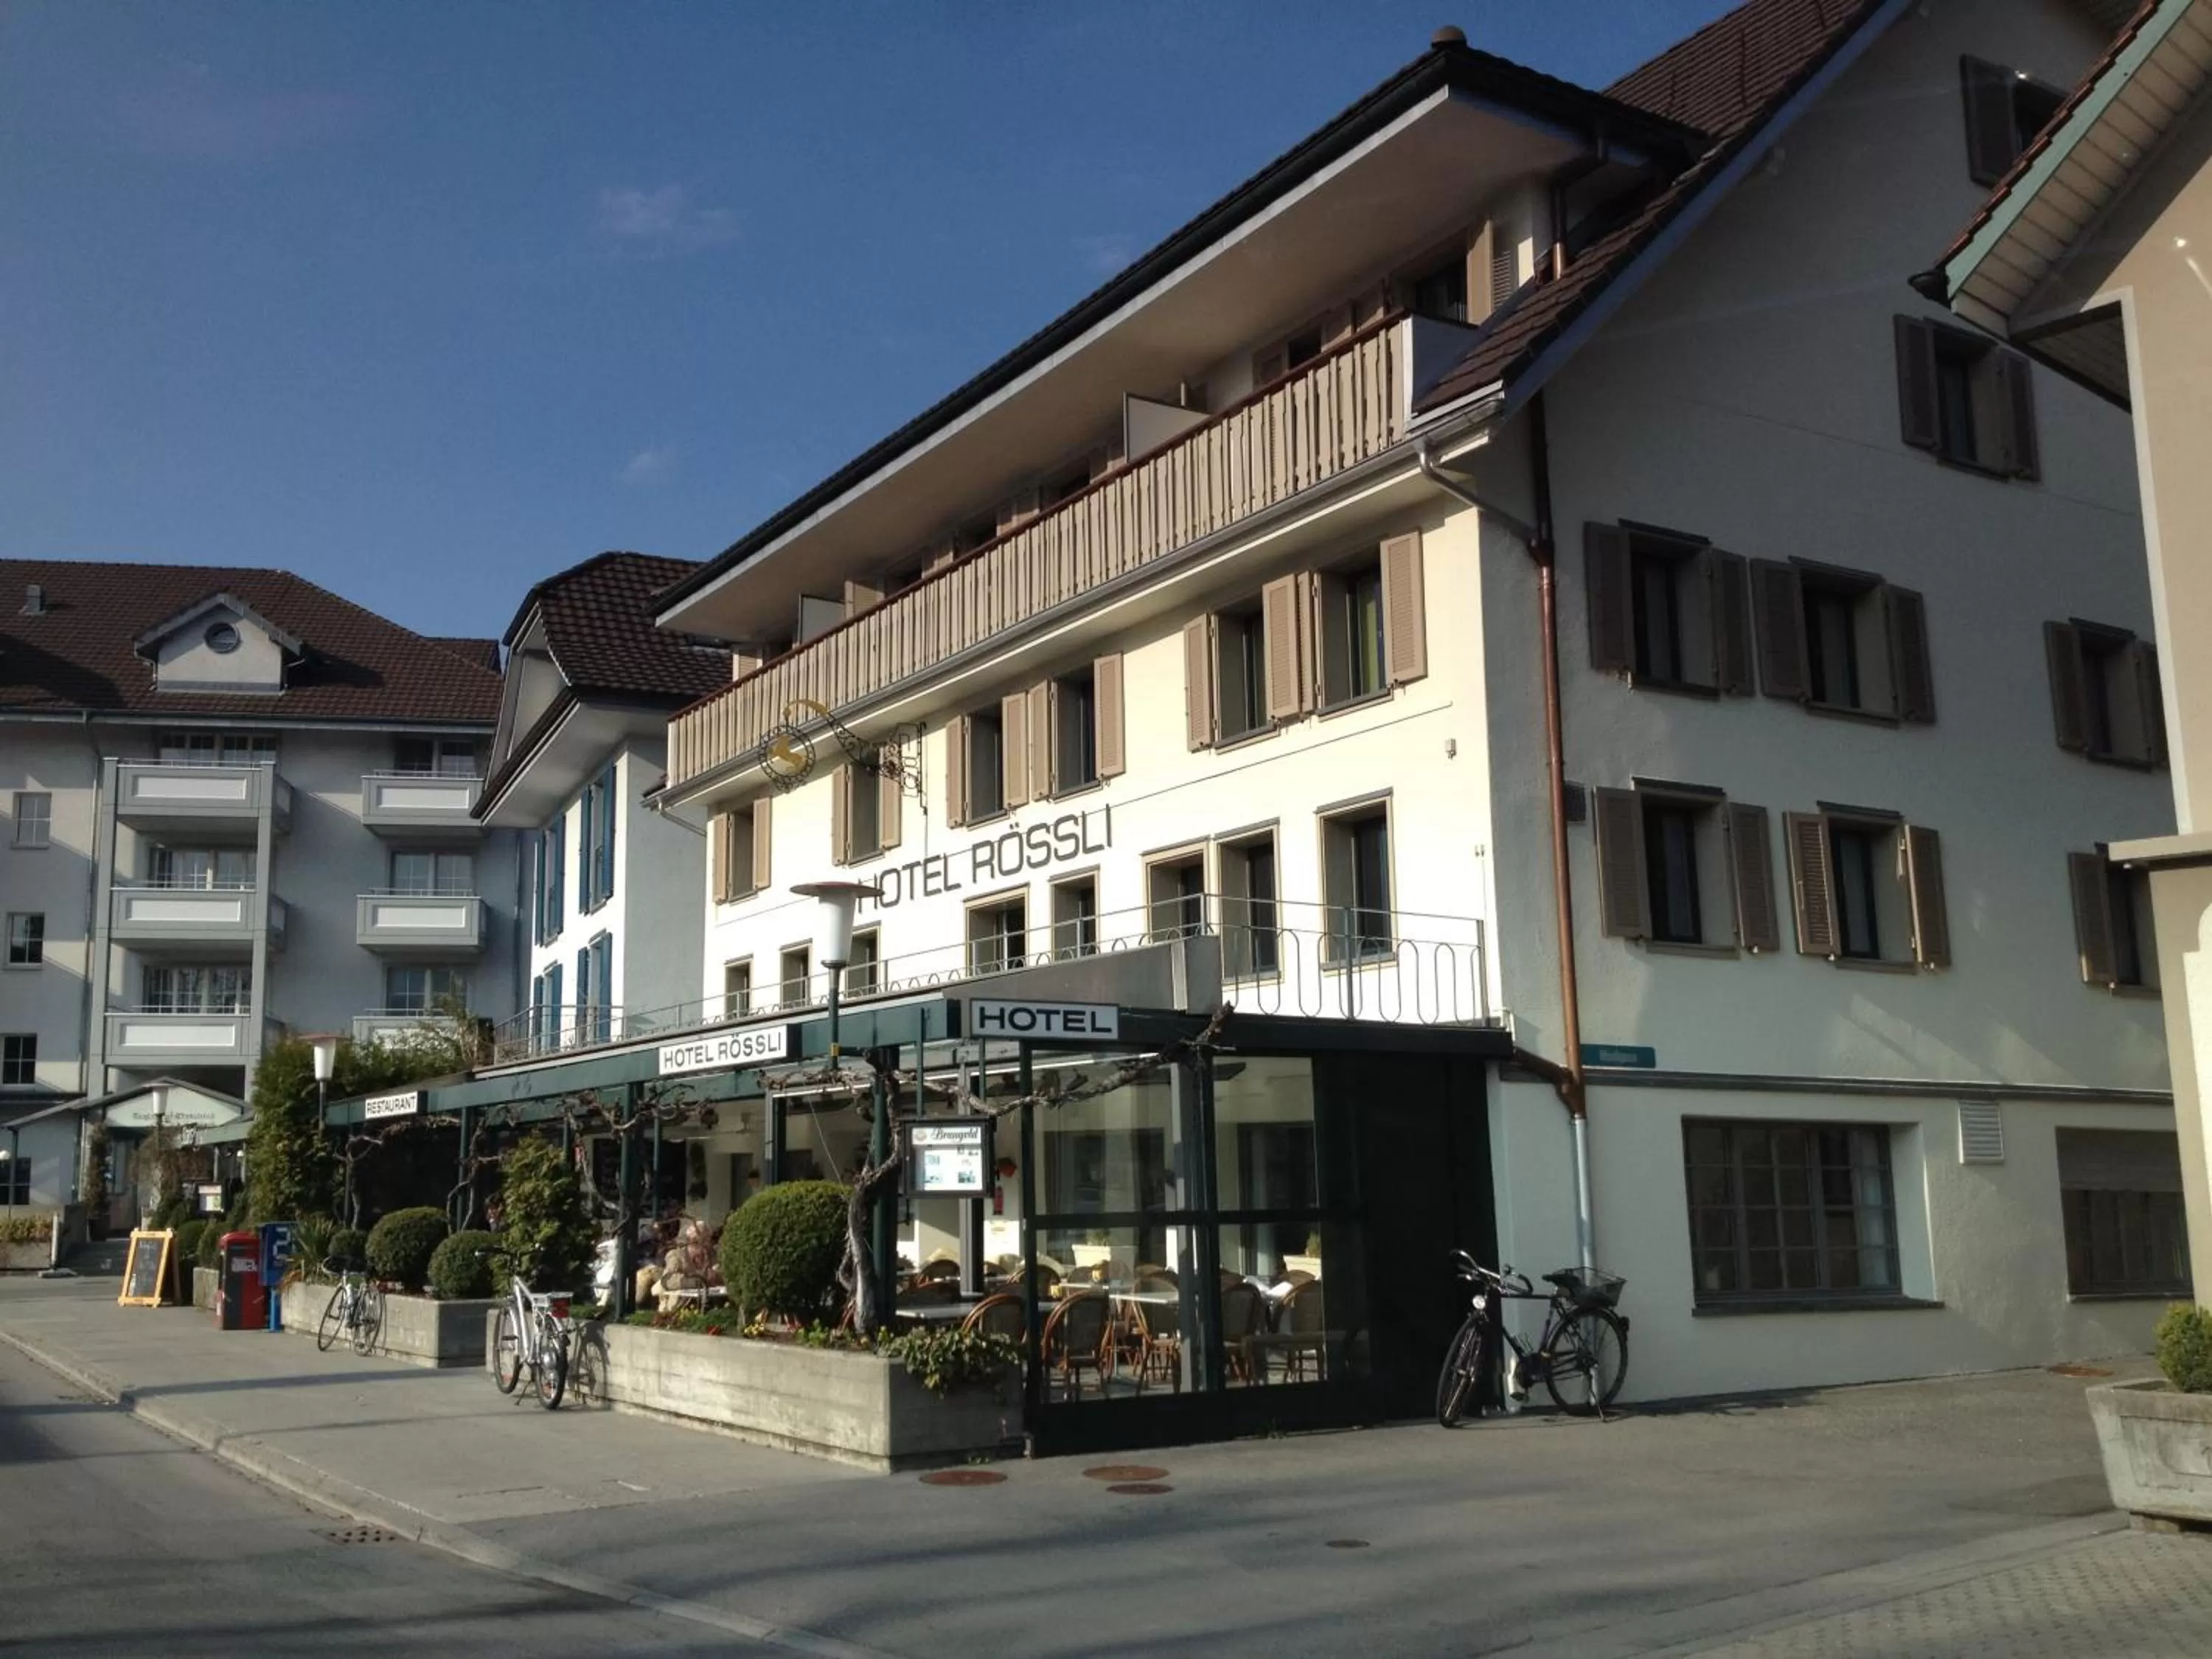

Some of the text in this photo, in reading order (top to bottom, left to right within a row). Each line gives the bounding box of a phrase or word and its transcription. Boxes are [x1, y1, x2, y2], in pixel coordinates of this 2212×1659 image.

[857, 803, 1113, 914] HOTEL RÖSSLI
[978, 1006, 1113, 1033] HOTEL
[664, 1032, 782, 1068] HOTEL RÖSSLI
[367, 1095, 416, 1114] RESTAURANT
